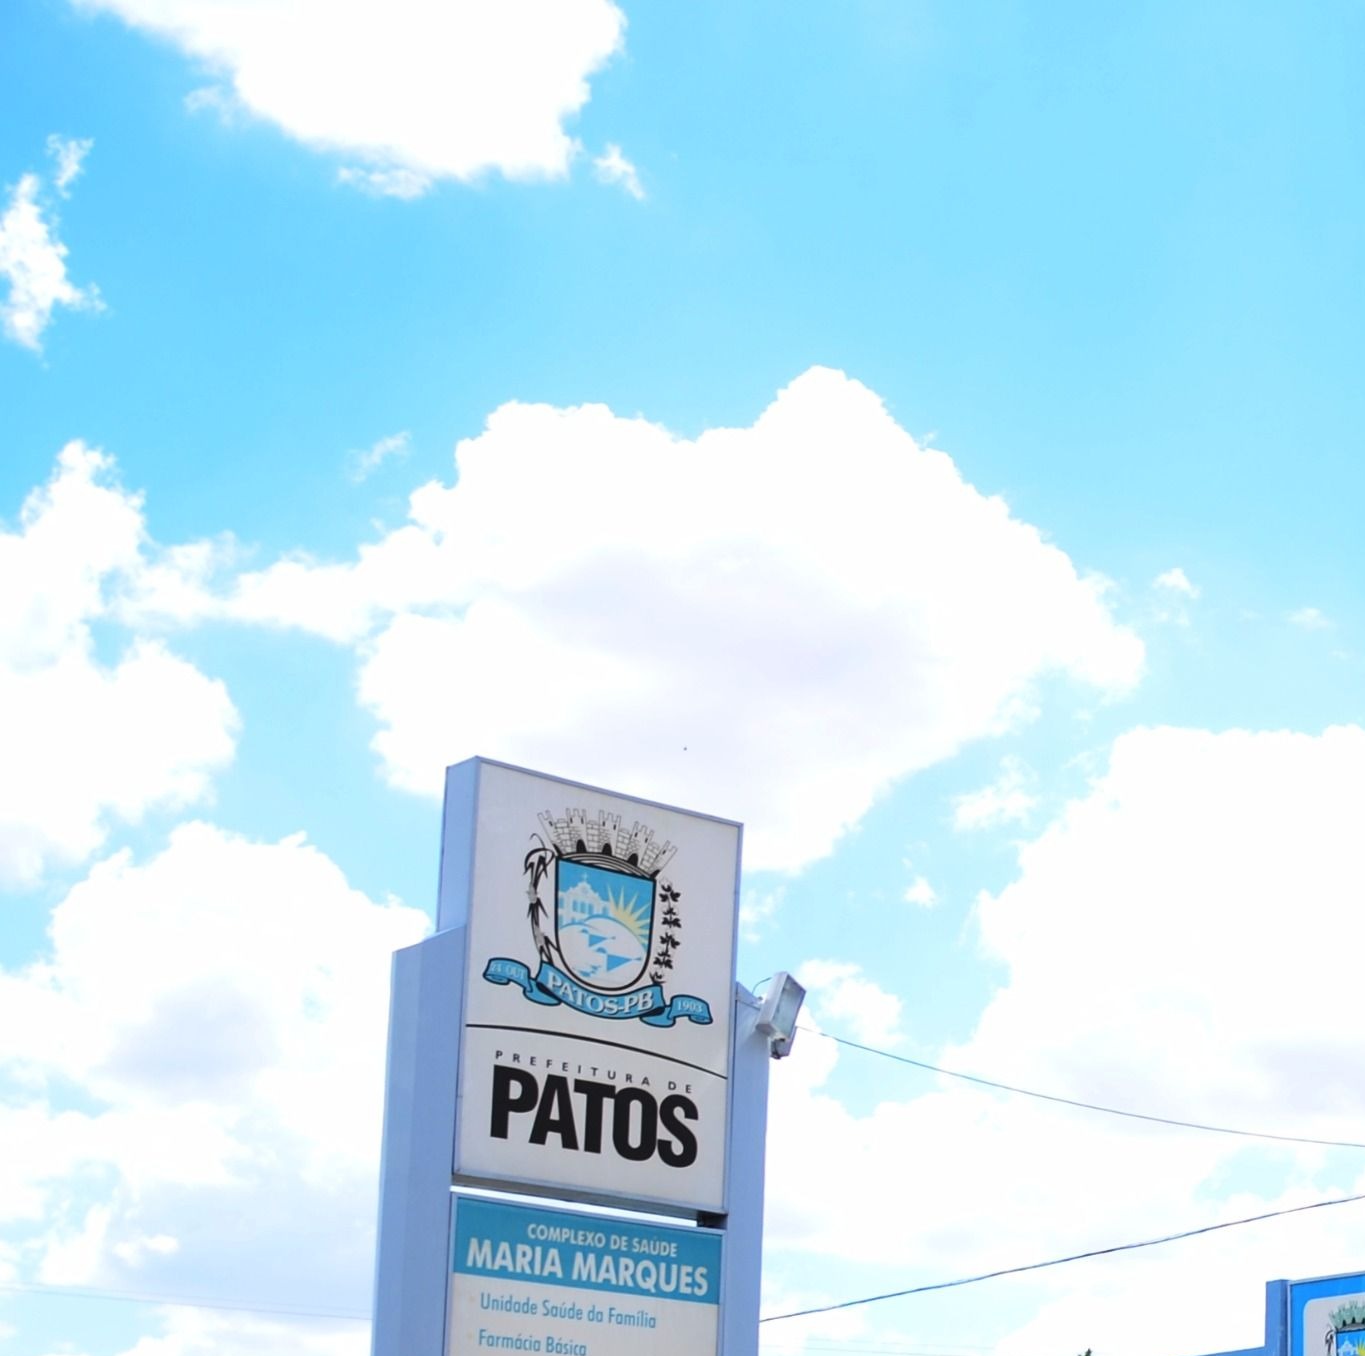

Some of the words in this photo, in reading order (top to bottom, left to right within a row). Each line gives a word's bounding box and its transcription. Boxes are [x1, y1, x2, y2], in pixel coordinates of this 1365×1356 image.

[546, 971, 654, 1015] PATOS-PB
[495, 1050, 650, 1087] PREFEITURA
[668, 1081, 693, 1095] DE
[490, 1064, 699, 1168] PATOS
[527, 1223, 606, 1248] COMPLEXO
[610, 1235, 629, 1251] DE
[632, 1236, 678, 1257] SAÚDE
[466, 1237, 563, 1278] MARIA
[572, 1251, 708, 1296] MARQUES
[480, 1292, 538, 1315] Unidade
[542, 1299, 583, 1321] Saúde
[587, 1305, 604, 1323] da
[608, 1307, 657, 1329] Família
[478, 1329, 541, 1352] Farmácia
[545, 1336, 587, 1356] Básica
